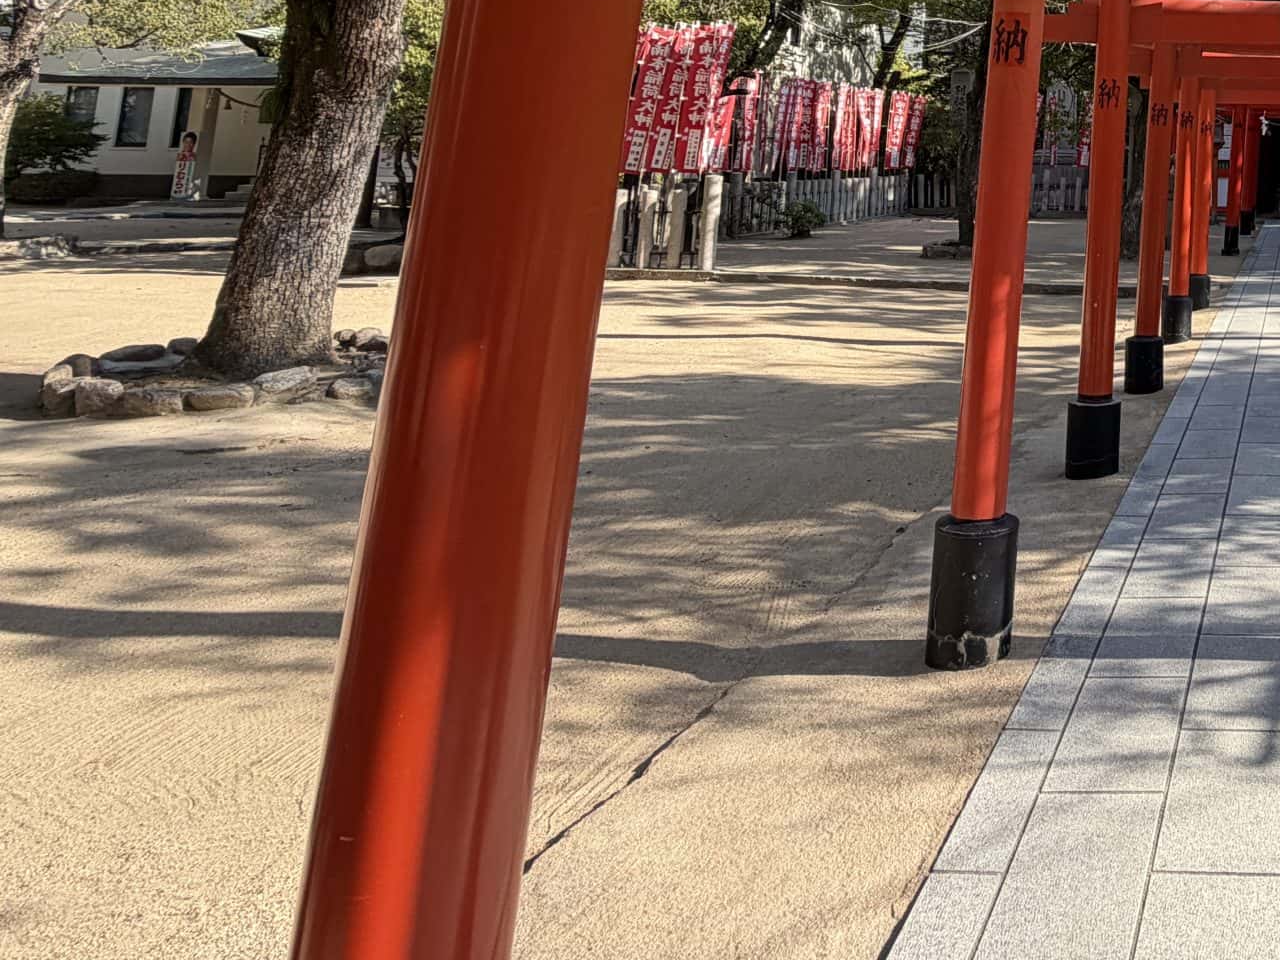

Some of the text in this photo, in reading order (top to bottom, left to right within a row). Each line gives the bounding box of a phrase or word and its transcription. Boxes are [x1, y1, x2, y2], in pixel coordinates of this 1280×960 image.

[993, 19, 1028, 64] 納
[1098, 78, 1121, 109] 納
[1151, 103, 1168, 127] 納
[1180, 110, 1194, 129] 納
